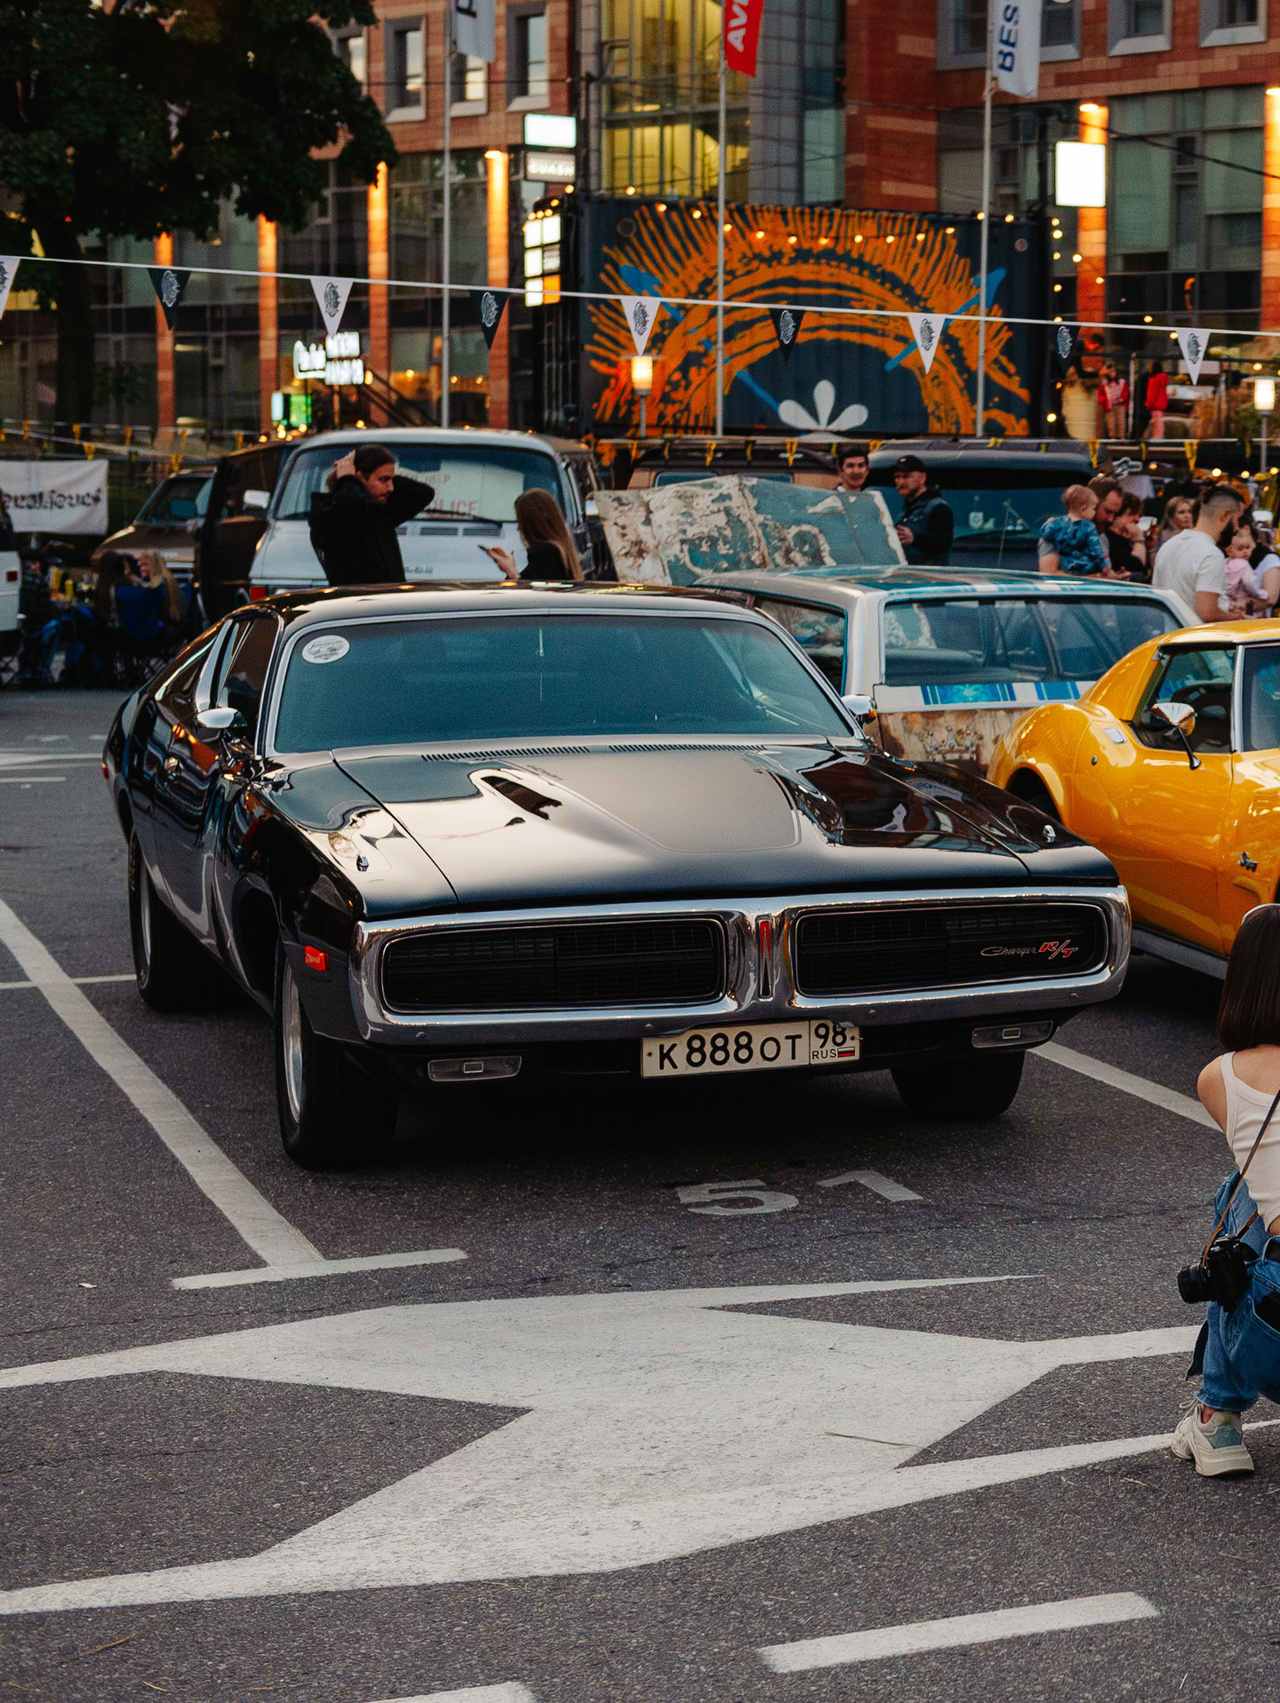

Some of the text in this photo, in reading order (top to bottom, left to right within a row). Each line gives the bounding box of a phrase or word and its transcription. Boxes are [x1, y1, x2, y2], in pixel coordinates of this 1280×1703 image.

[980, 939, 1079, 960] Charger R/T
[814, 1022, 847, 1049] 98
[812, 1048, 837, 1060] RUS
[676, 1170, 925, 1216] 51
